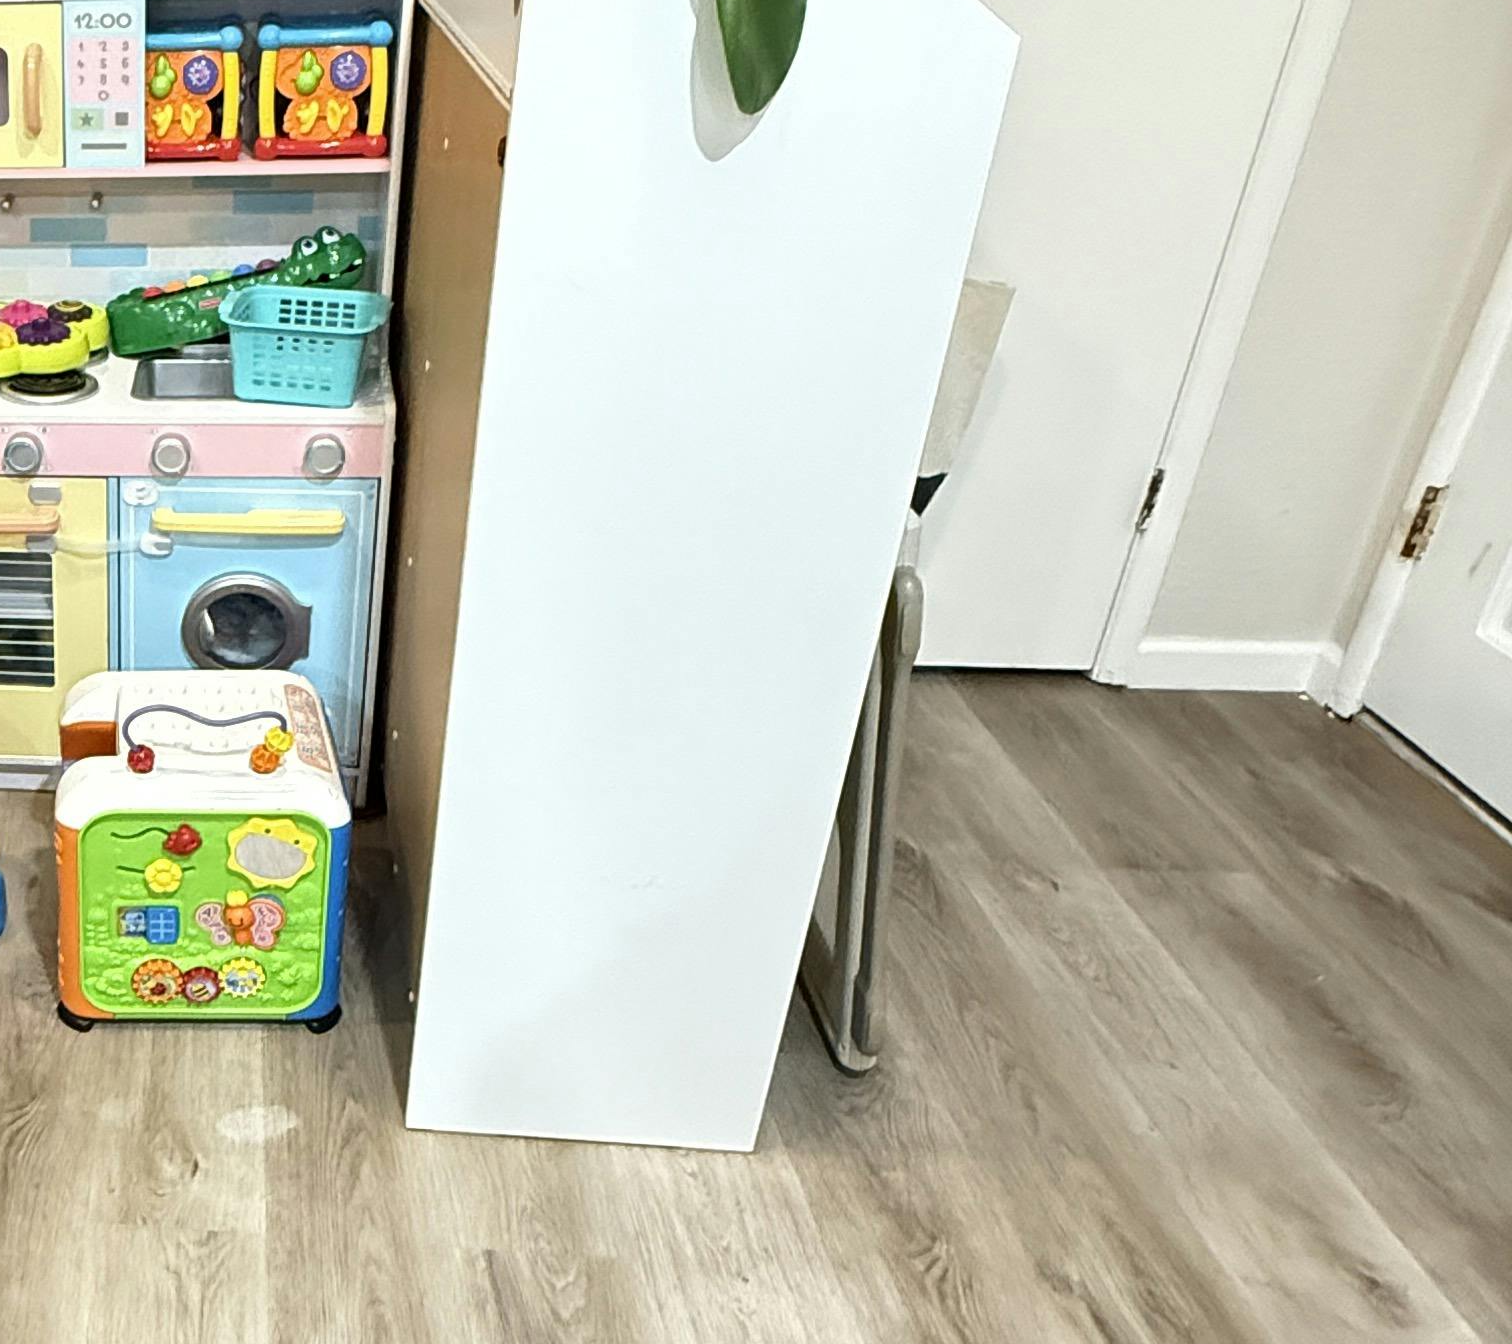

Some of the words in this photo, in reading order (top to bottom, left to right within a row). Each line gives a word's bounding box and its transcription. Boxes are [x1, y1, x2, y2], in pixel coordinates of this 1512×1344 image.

[74, 12, 132, 29] 12:00
[79, 41, 84, 52] 1
[98, 40, 107, 52] 2
[100, 57, 107, 69] 5
[121, 57, 129, 69] 6
[98, 90, 109, 102] 0
